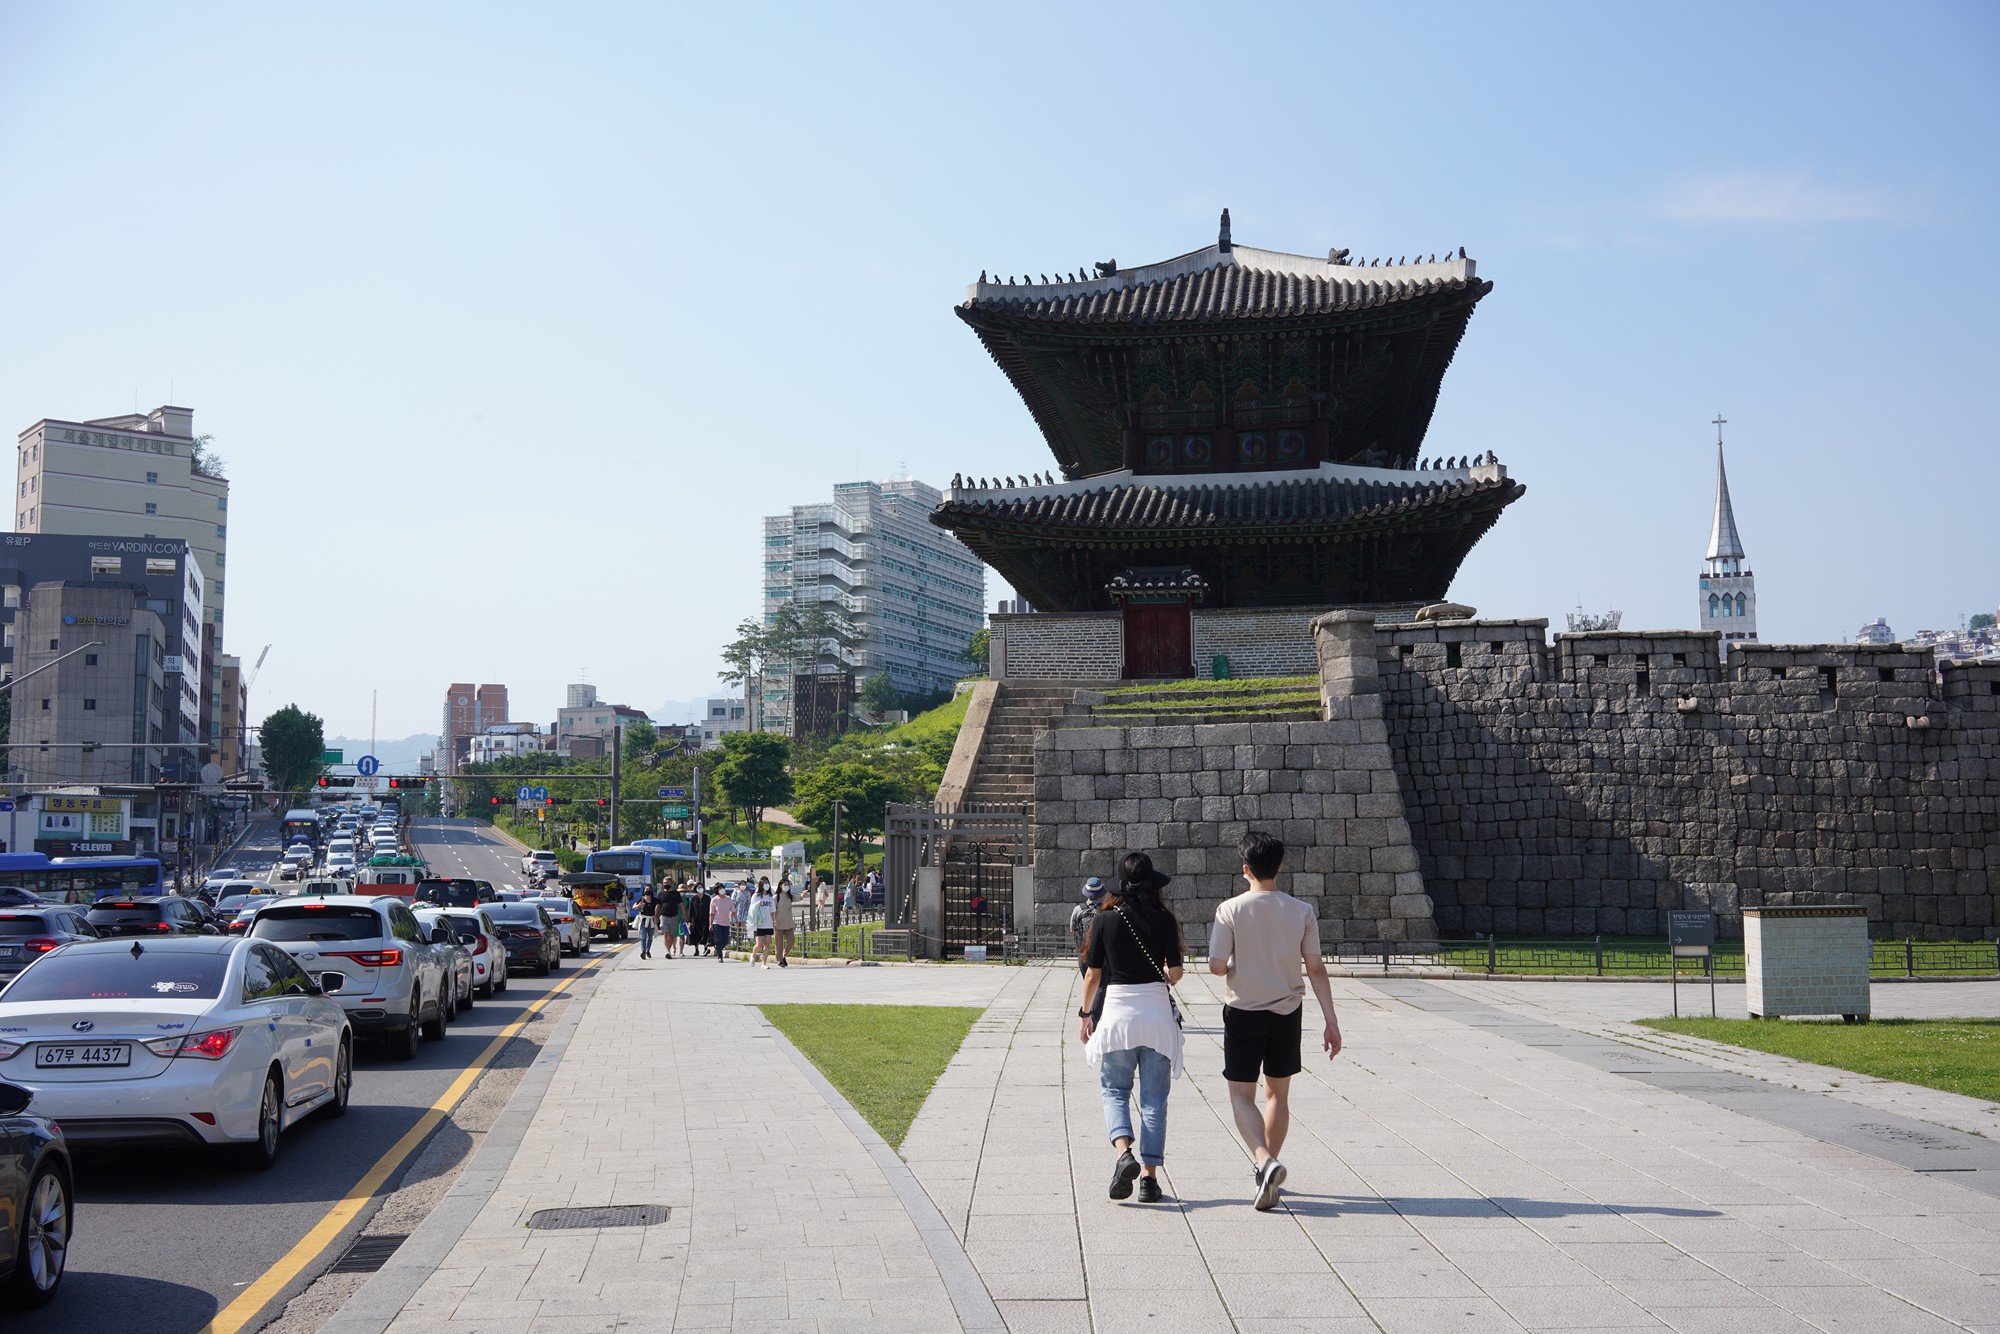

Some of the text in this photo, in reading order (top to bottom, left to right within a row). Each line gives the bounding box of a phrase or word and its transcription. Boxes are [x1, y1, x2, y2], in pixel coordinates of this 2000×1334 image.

[112, 541, 184, 554] YARDIN.COM
[626, 861, 640, 869] 152
[81, 1047, 123, 1062] 4437
